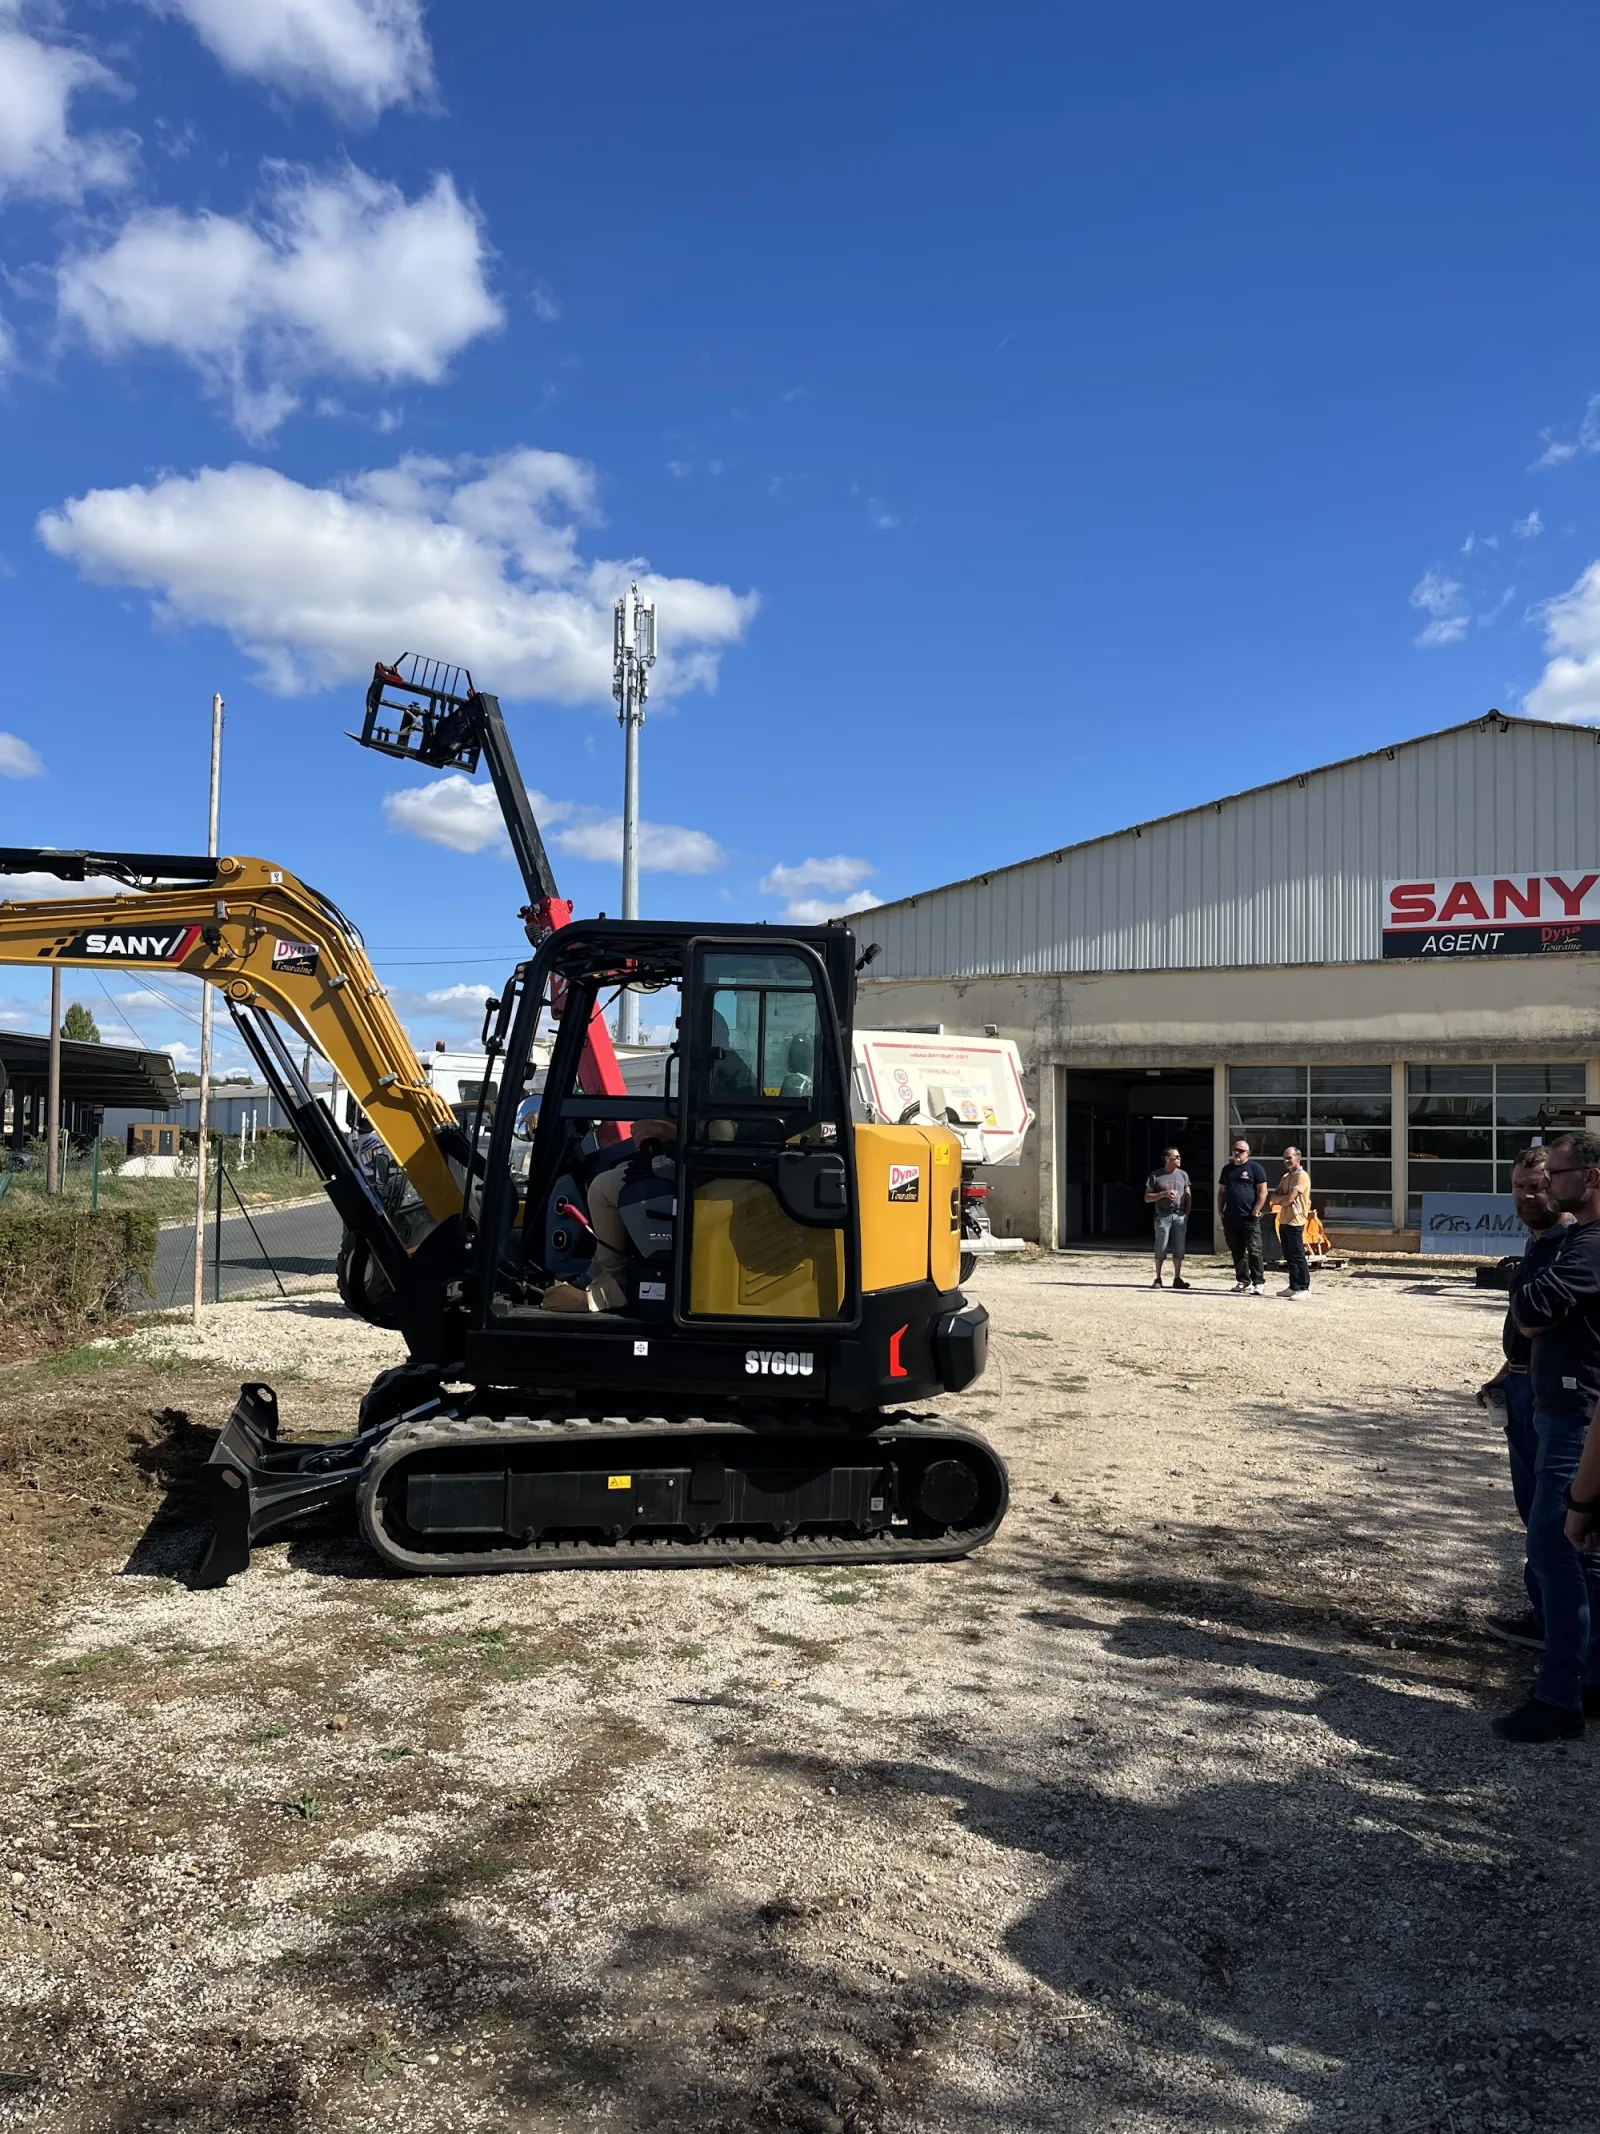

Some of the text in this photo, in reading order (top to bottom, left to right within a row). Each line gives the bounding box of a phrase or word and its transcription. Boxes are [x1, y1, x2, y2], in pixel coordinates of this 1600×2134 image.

[1389, 874, 1600, 924] SANY
[1421, 932, 1505, 953] AGENT
[1541, 925, 1581, 943] Dyna
[85, 934, 171, 956] SANY
[277, 942, 316, 958] Dyna
[1541, 941, 1582, 952] Touraine
[274, 960, 313, 975] Touraine
[891, 1167, 918, 1186] Dyna
[890, 1189, 918, 1200] Touraine
[745, 1350, 814, 1376] SY60U
